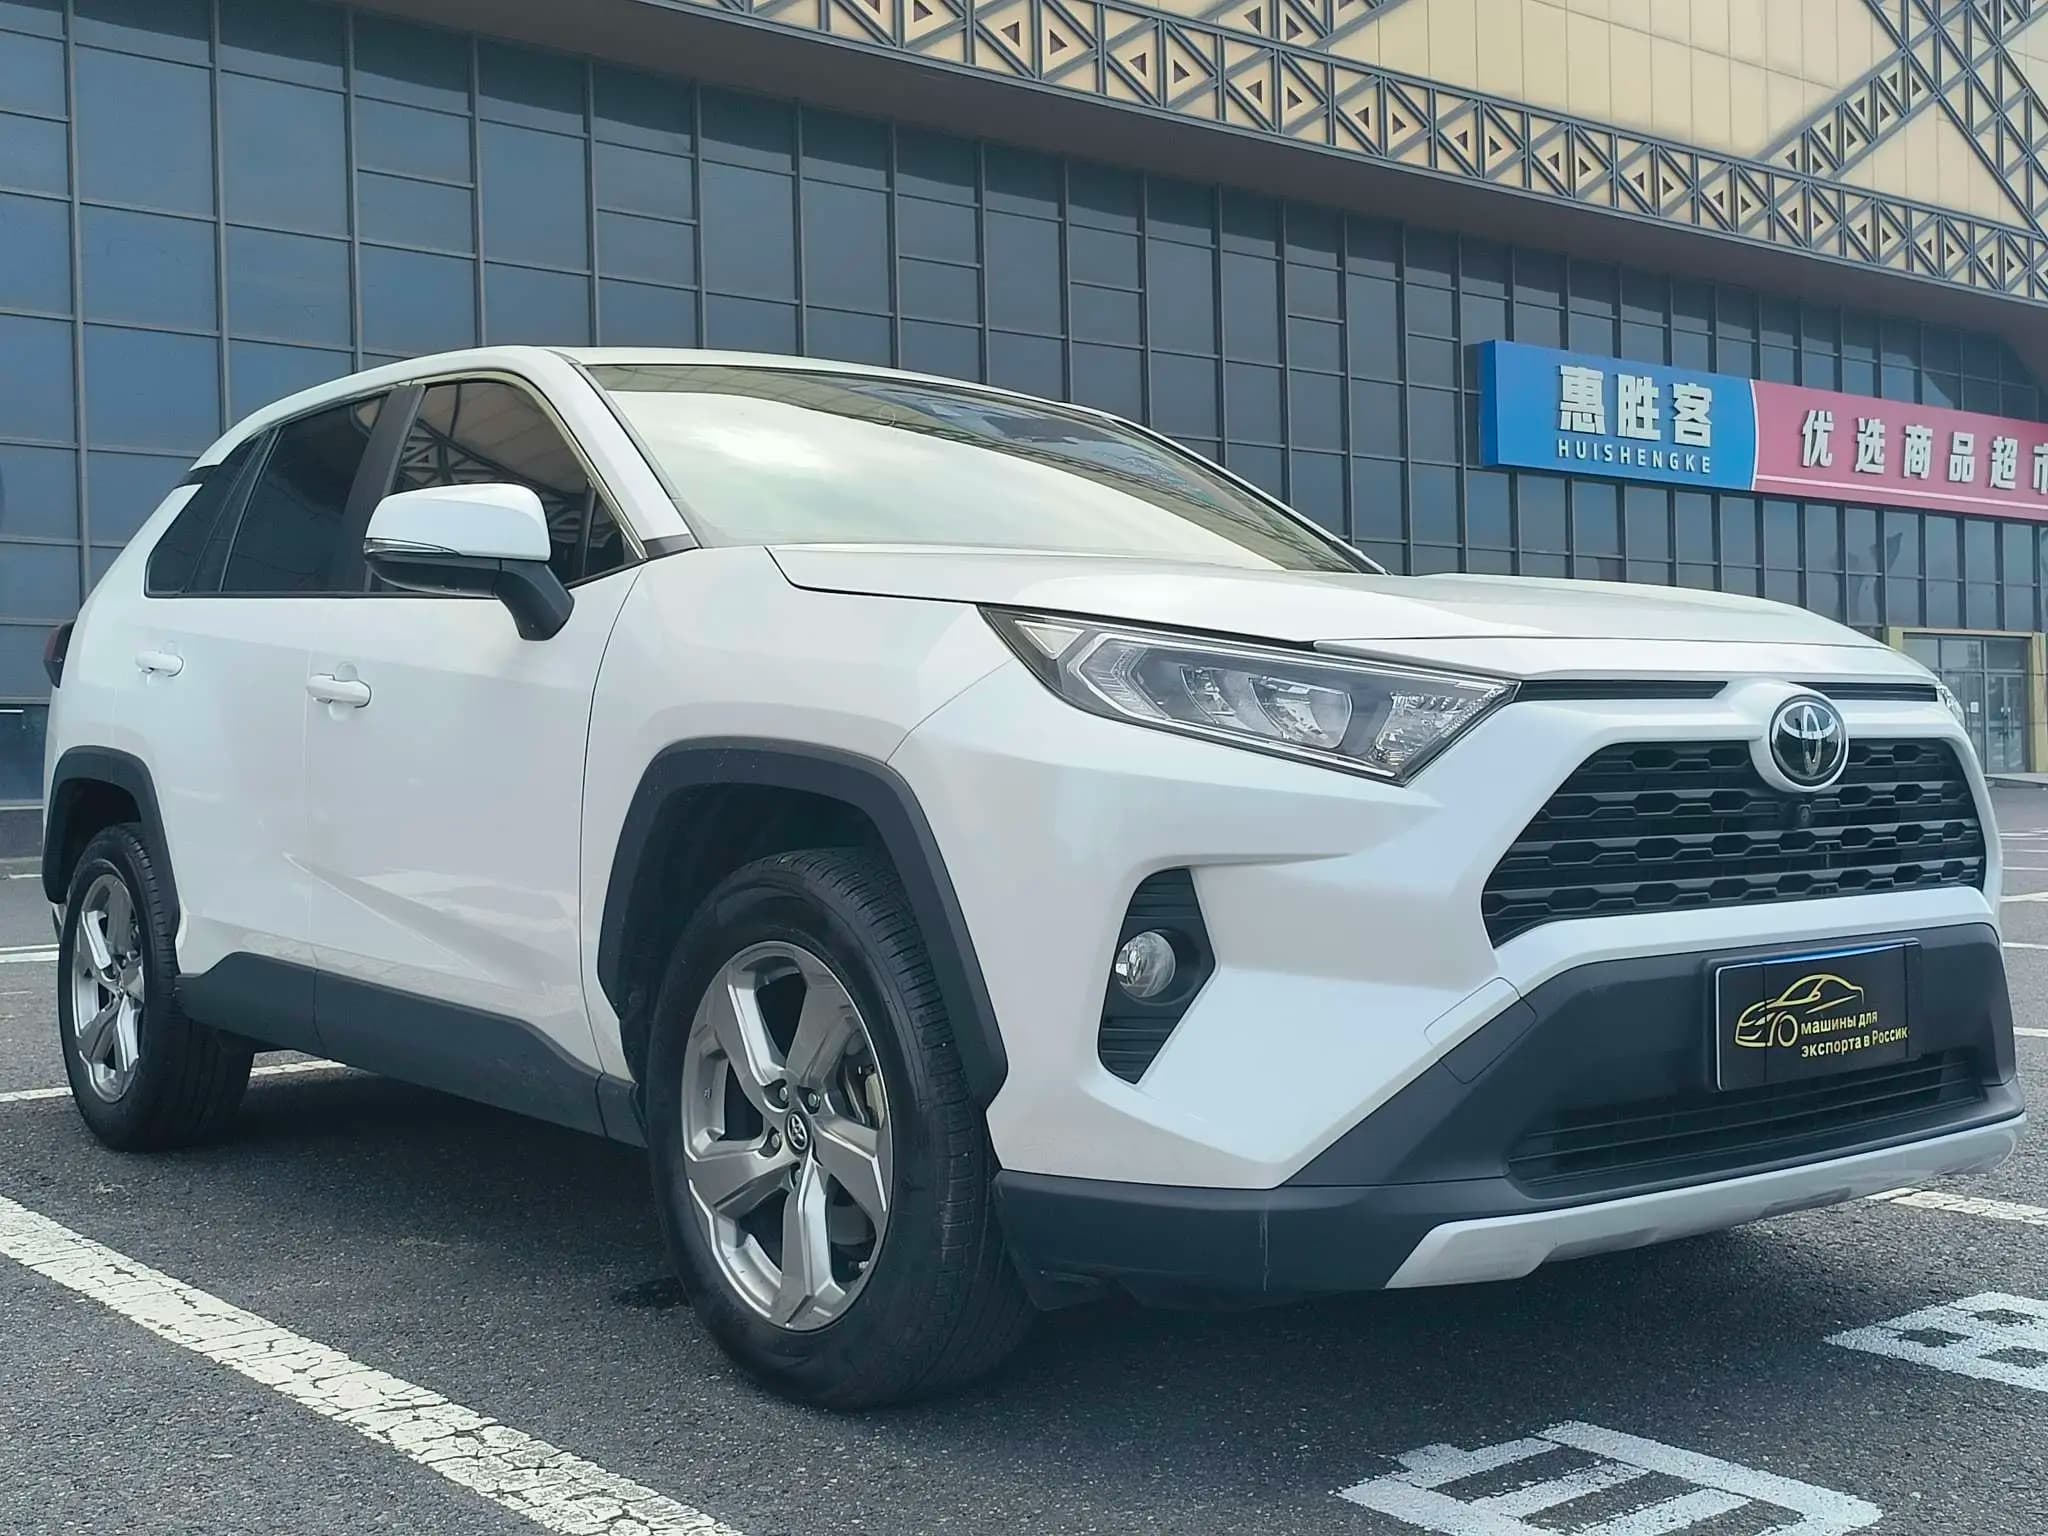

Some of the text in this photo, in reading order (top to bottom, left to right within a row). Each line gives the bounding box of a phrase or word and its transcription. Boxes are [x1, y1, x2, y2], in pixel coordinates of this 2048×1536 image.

[1560, 365, 1713, 448] 惠胜客
[1558, 439, 1711, 473] HUISHENGKE
[1802, 409, 2048, 494] 优选商品超市
[1858, 1011, 1878, 1028] для
[1801, 1036, 1862, 1059] экспорта
[1863, 1035, 1870, 1048] в
